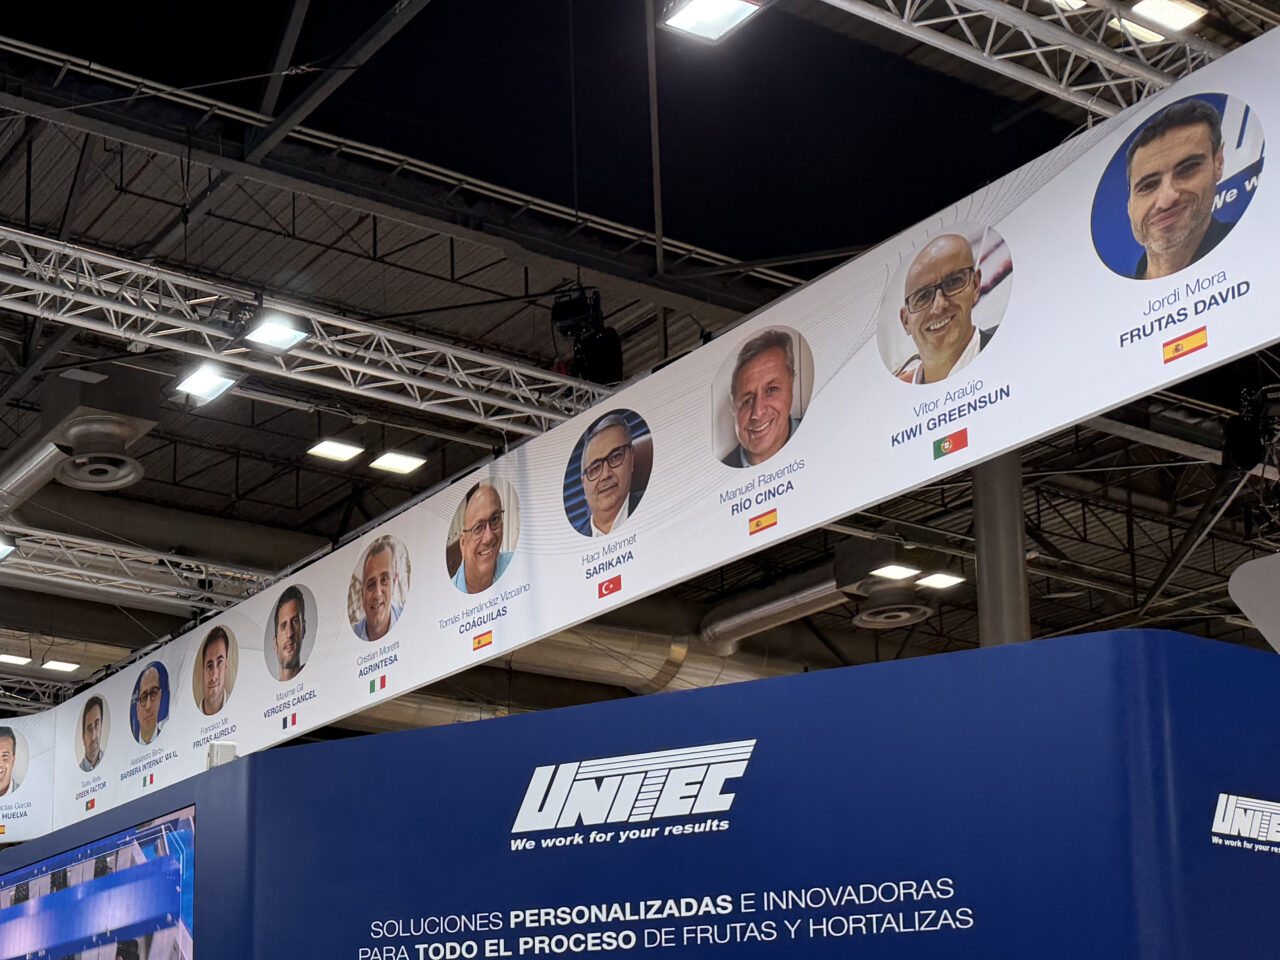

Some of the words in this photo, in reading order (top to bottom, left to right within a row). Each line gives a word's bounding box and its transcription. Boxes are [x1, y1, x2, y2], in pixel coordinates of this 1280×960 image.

[1143, 287, 1180, 316] Jordi
[1185, 269, 1227, 297] Mora
[1119, 308, 1189, 348] FRUTAS
[1194, 280, 1251, 316] DAVID
[944, 378, 984, 408] Araújo
[891, 424, 923, 448] KIWI
[926, 384, 1011, 430] GREENSUN
[720, 481, 755, 504] Manuel
[758, 459, 805, 487] Raventós
[731, 496, 752, 516] RÍO
[755, 481, 794, 505] CINCA
[602, 534, 637, 555] Mehmet
[585, 551, 634, 579] SARIKAYA
[439, 614, 461, 629] Tomás
[462, 597, 499, 619] Hernández
[459, 606, 508, 634] COÁGUILAS
[357, 650, 378, 666] Cristian
[358, 655, 398, 678] AGRINTESA
[264, 700, 291, 719] VERGERS
[292, 690, 317, 708] CANCEL
[276, 686, 296, 702] Maxime
[193, 735, 213, 749] FRUTAS
[510, 739, 757, 833] UNITEC
[2, 811, 28, 820] HUELVA
[1211, 793, 1280, 842] UNITE
[510, 838, 536, 851] We
[540, 830, 584, 848] work
[589, 829, 615, 844] for
[618, 826, 660, 844] your
[663, 818, 730, 836] results
[1211, 835, 1223, 844] We
[1224, 839, 1242, 848] work
[1243, 840, 1253, 849] for
[1254, 843, 1270, 852] your
[370, 911, 503, 939] SOLUCIONES
[509, 895, 733, 928] PERSONALIZADAS
[740, 892, 756, 913] E
[763, 877, 955, 911] INNOVADORAS
[415, 940, 478, 960] TODO
[484, 938, 513, 958] EL
[519, 930, 636, 955] PROCESO
[644, 928, 676, 947] DE
[683, 920, 778, 945] FRUTAS
[783, 918, 802, 939] Y
[809, 907, 975, 938] HORTALIZAS
